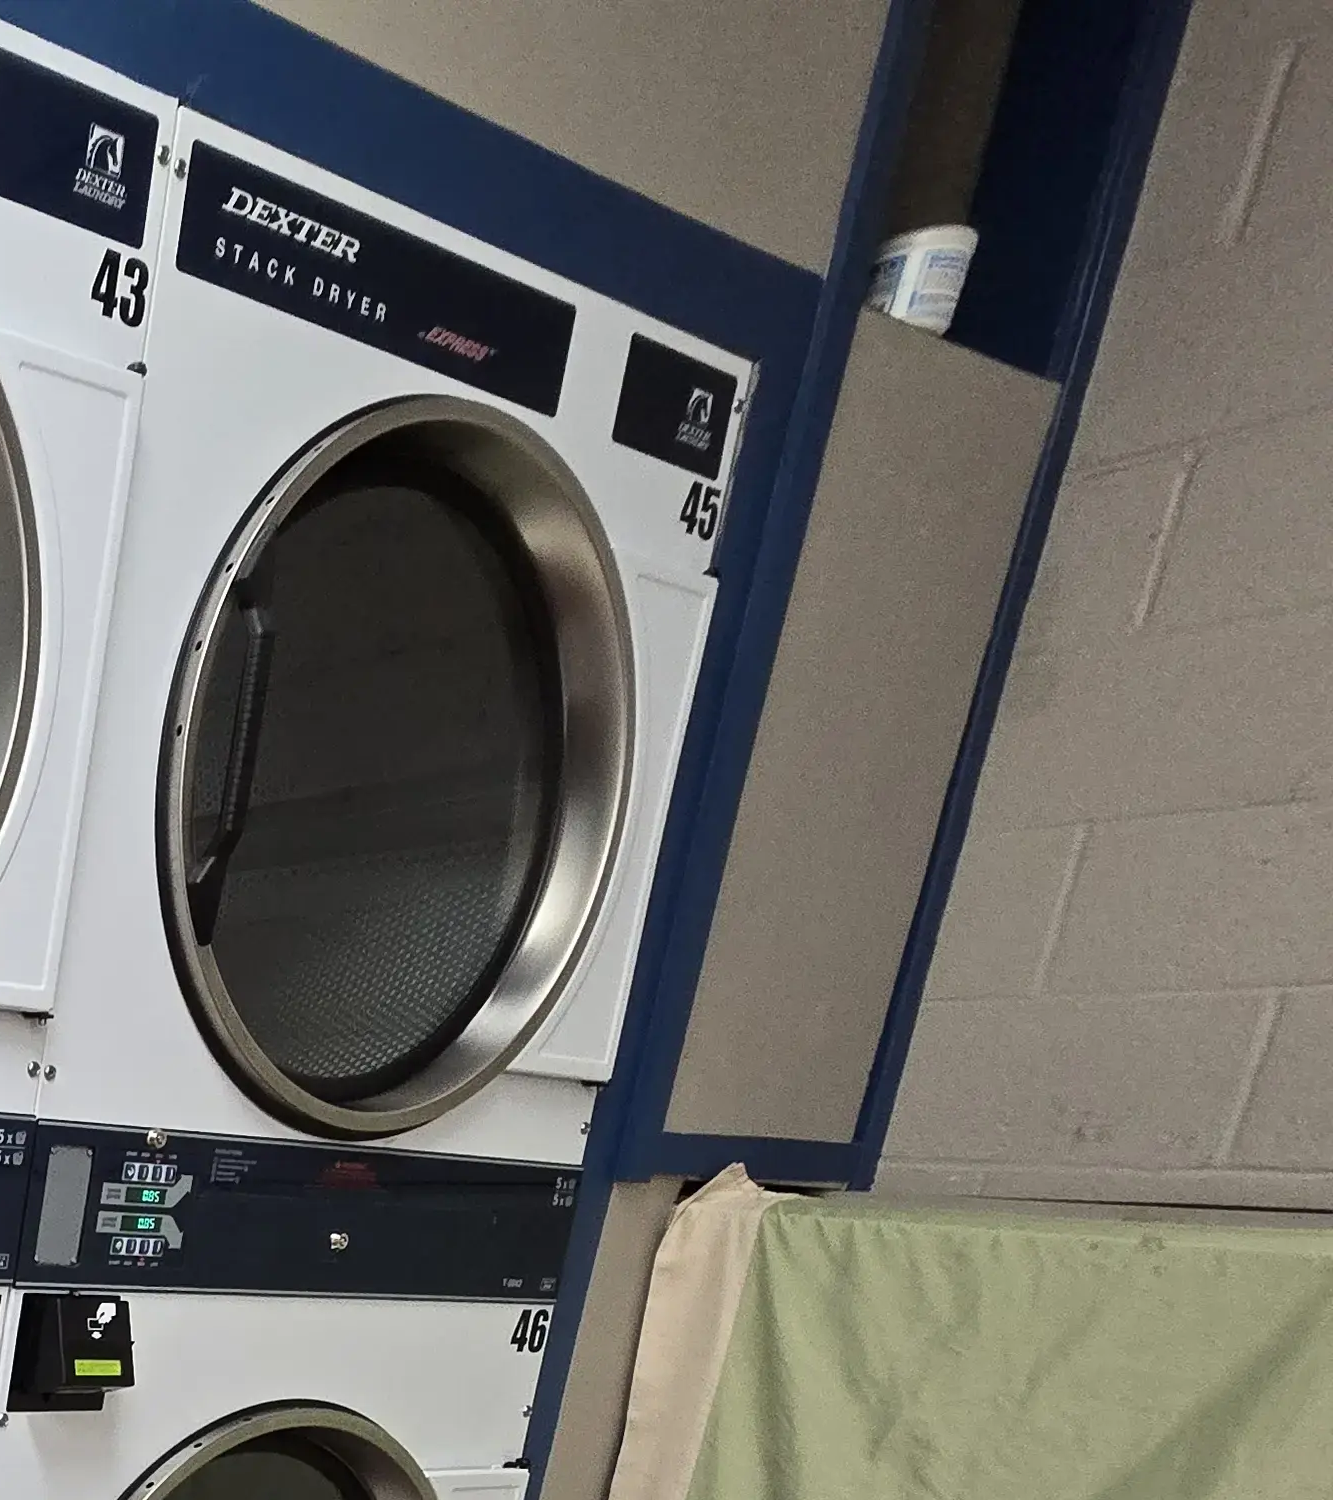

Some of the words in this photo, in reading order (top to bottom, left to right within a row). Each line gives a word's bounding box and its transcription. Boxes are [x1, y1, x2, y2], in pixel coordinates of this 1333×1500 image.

[73, 181, 126, 210] LAUNDRY
[75, 167, 126, 198] DEXTER
[222, 187, 361, 263] DEXTER
[91, 248, 149, 328] 43
[215, 236, 296, 286] STACK
[312, 276, 387, 323] DRYER
[425, 326, 489, 362] EXPRESS
[680, 480, 722, 541] 45
[510, 1309, 549, 1352] 46
